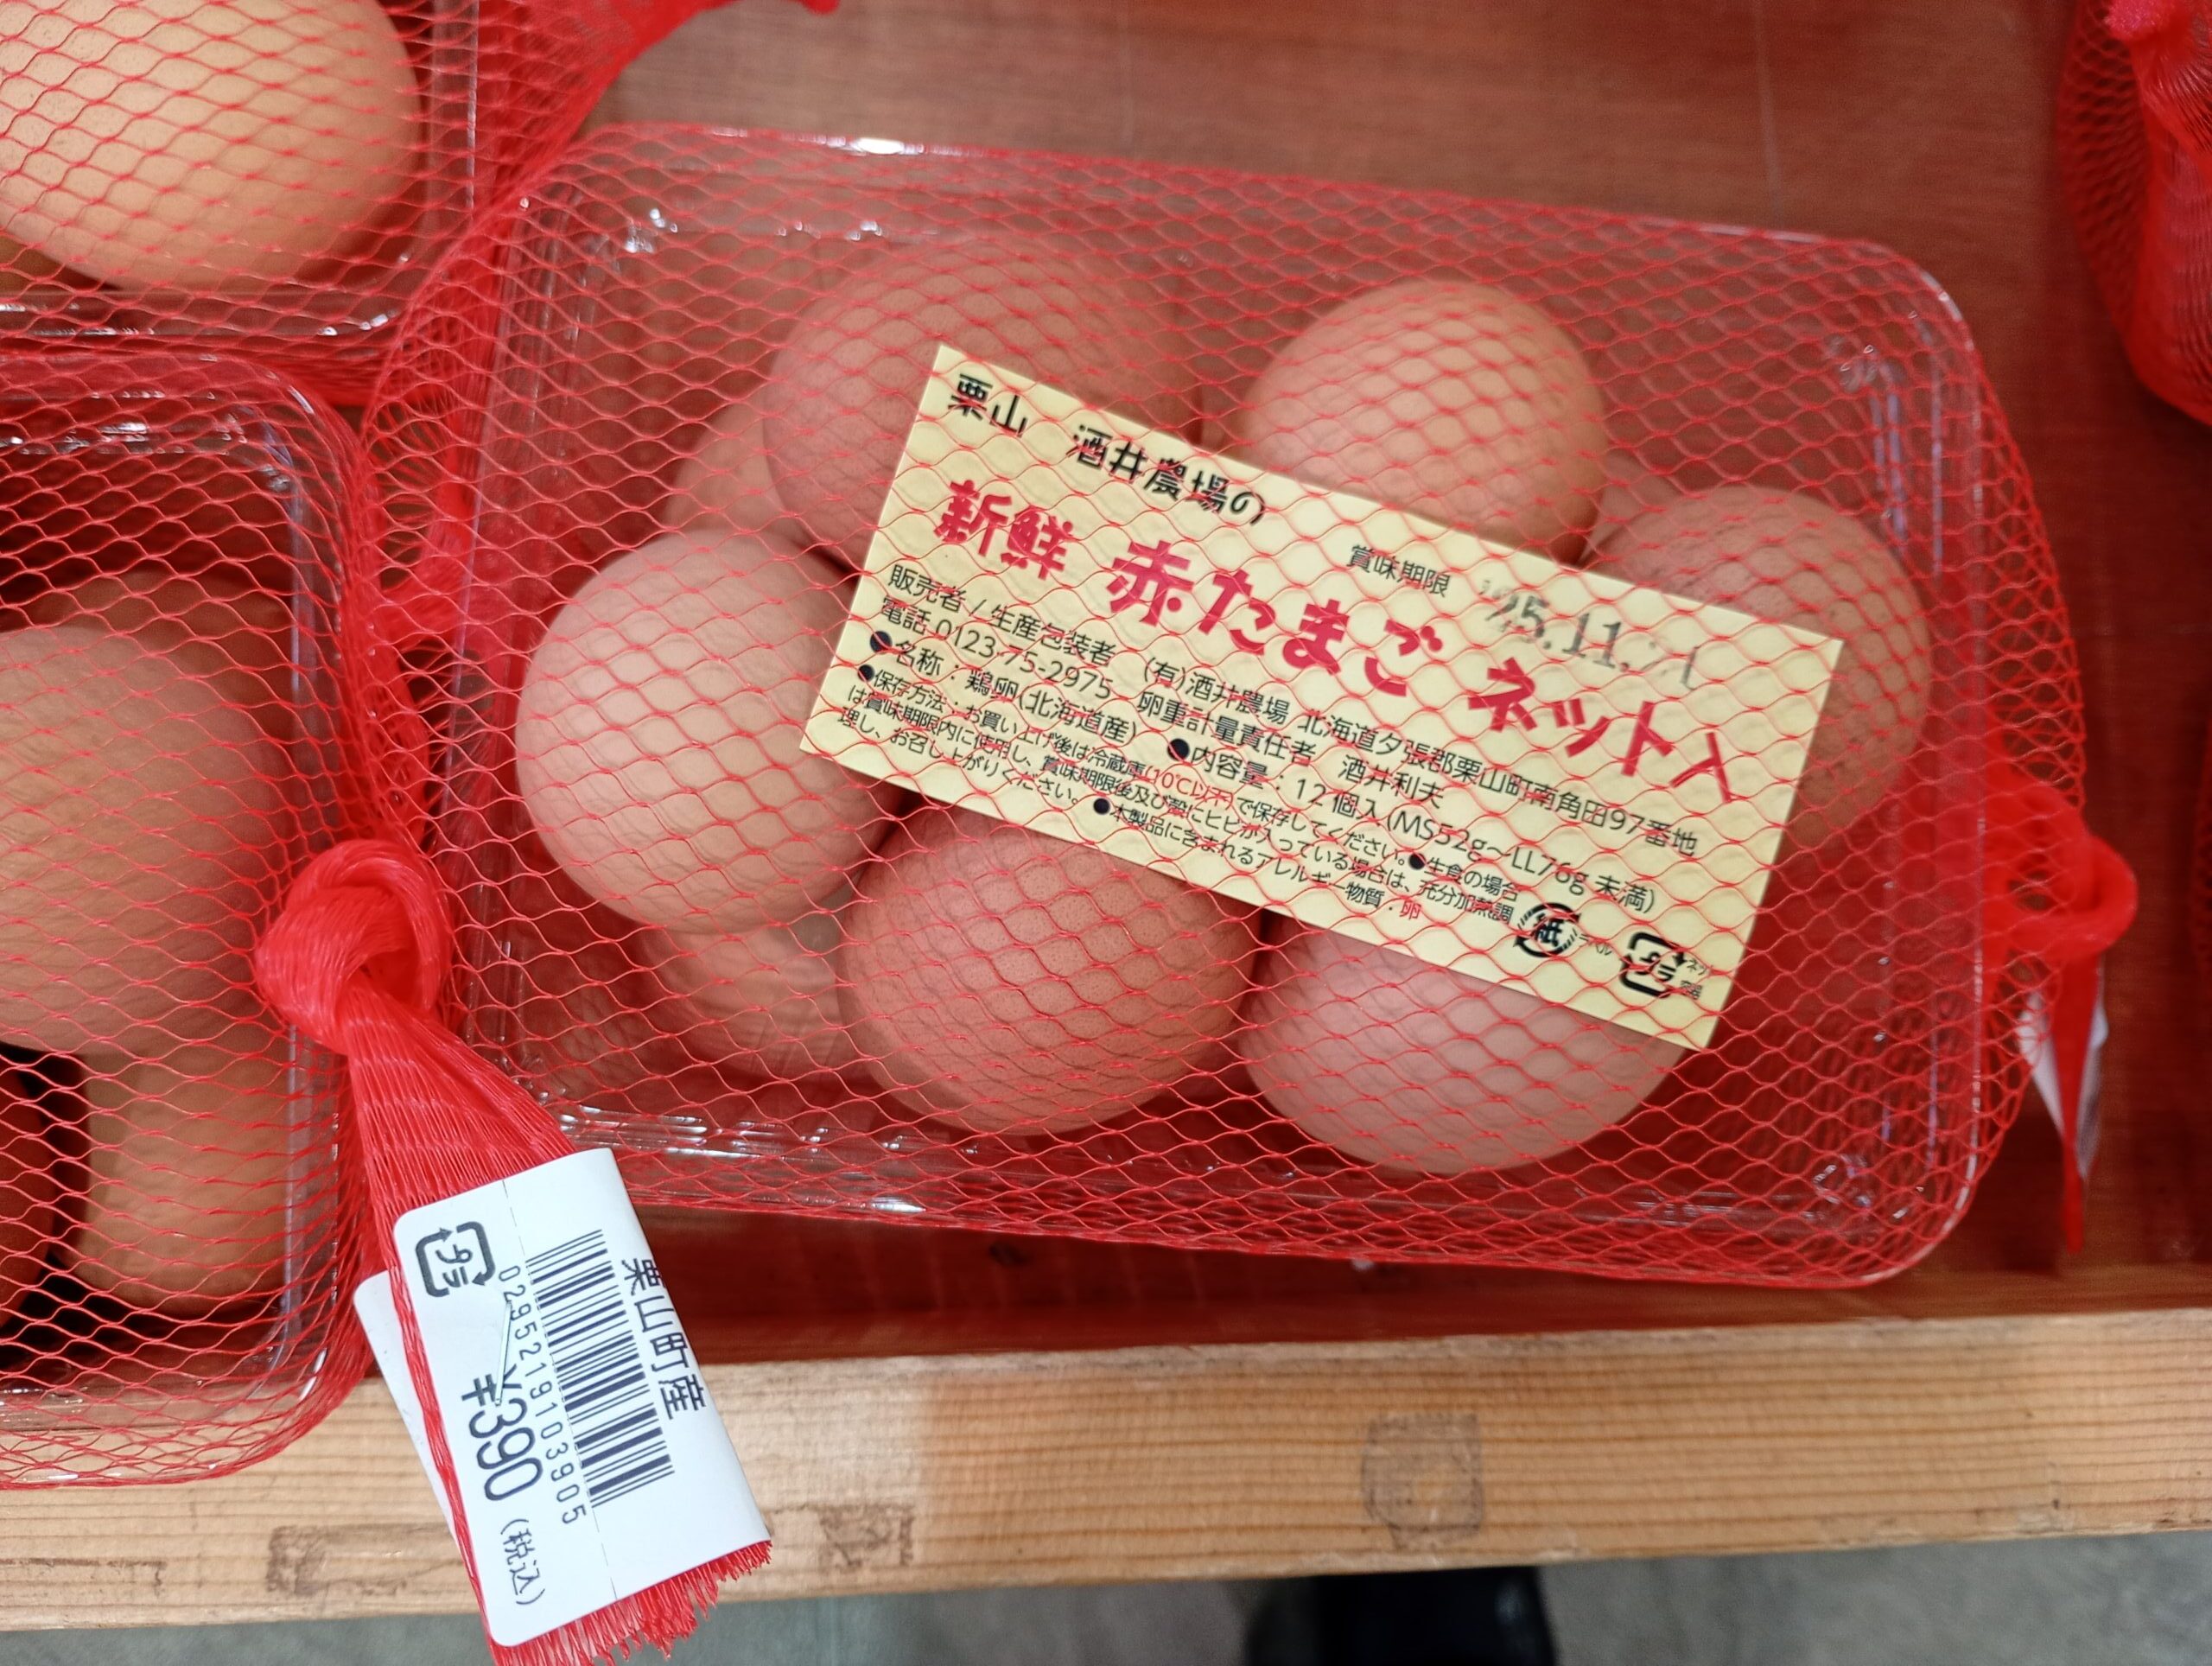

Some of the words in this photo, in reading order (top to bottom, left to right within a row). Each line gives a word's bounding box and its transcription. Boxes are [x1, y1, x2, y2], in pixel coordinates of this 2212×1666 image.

[948, 374, 1027, 437] 栗山
[1068, 425, 1264, 525] 酒井農場の
[934, 480, 1075, 580] 新鮮
[1106, 539, 1443, 697] 赤たまご
[1467, 656, 1734, 804] ネット入
[1348, 545, 1450, 595] 賞味期限
[1338, 755, 1443, 809] 酒井利夫
[499, 1265, 587, 1524] 0295219103905
[621, 1258, 706, 1420] 栗山町産
[461, 1364, 543, 1502] ¥390
[500, 1518, 545, 1606] (税込)
